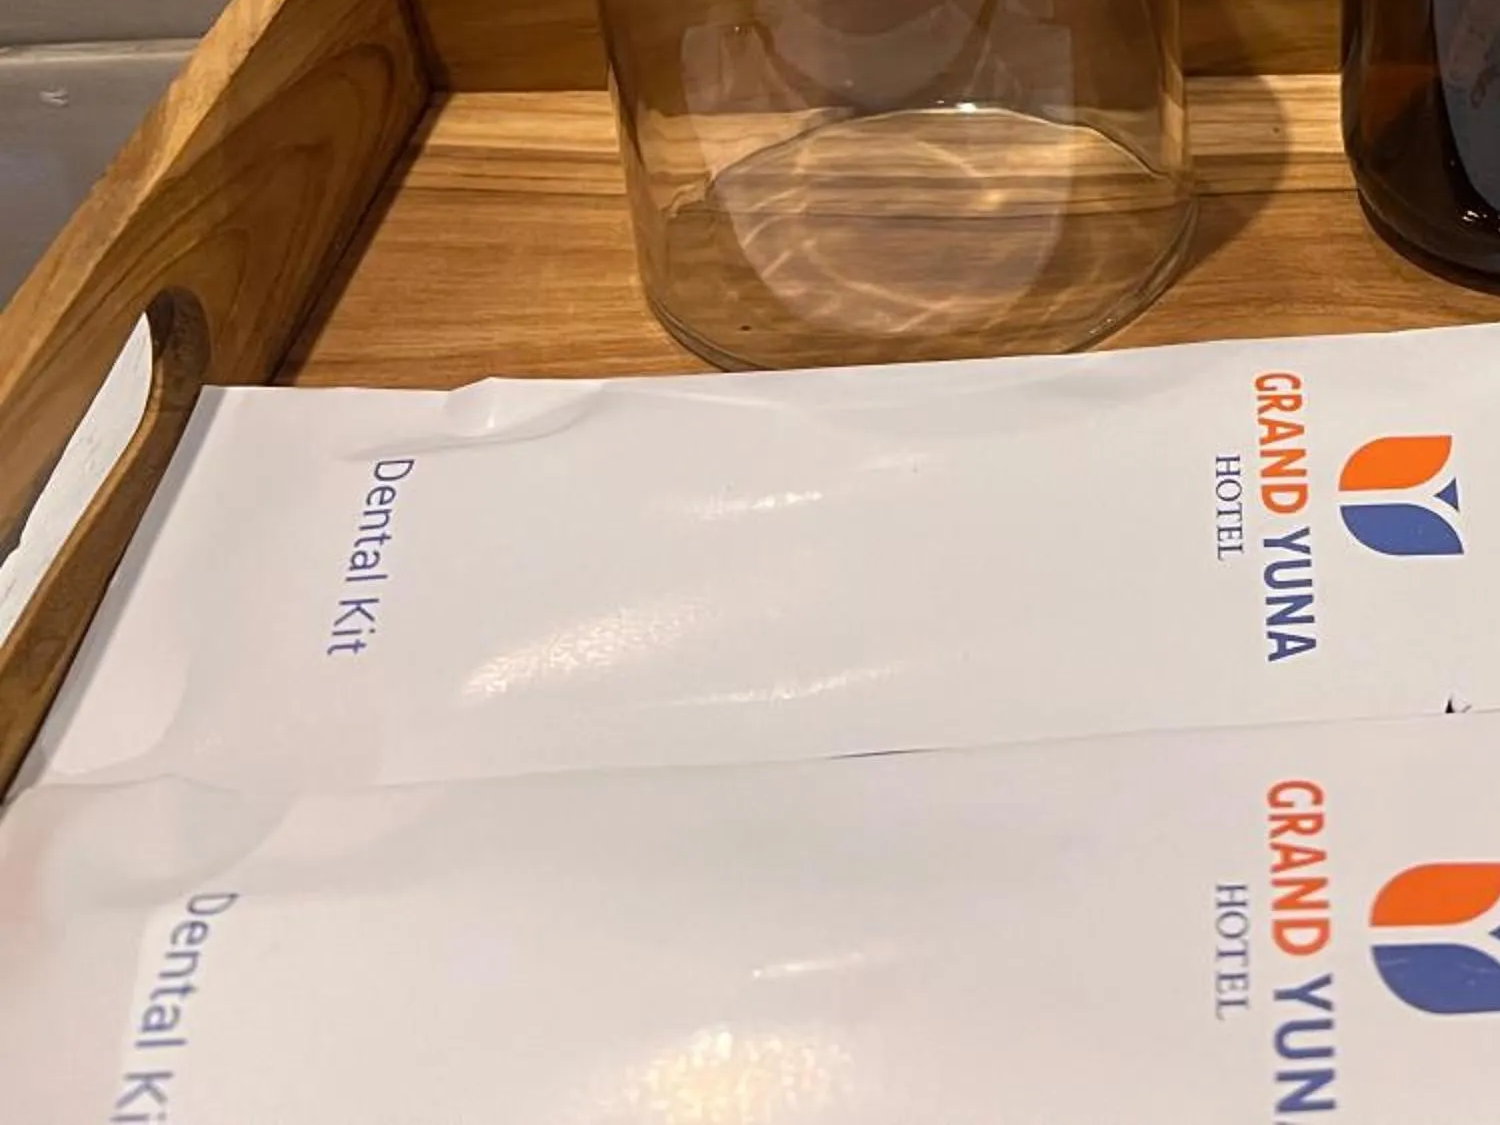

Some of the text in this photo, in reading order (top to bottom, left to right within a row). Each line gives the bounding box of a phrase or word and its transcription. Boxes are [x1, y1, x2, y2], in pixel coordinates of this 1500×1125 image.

[327, 458, 414, 656] Dental Kit
[1215, 454, 1244, 560] HOTEL
[1254, 372, 1318, 662] GRAND YUNA
[109, 893, 239, 1125] Dental Ki
[1215, 882, 1250, 1018] HOTEL
[1267, 780, 1337, 1125] GRAND YUN
